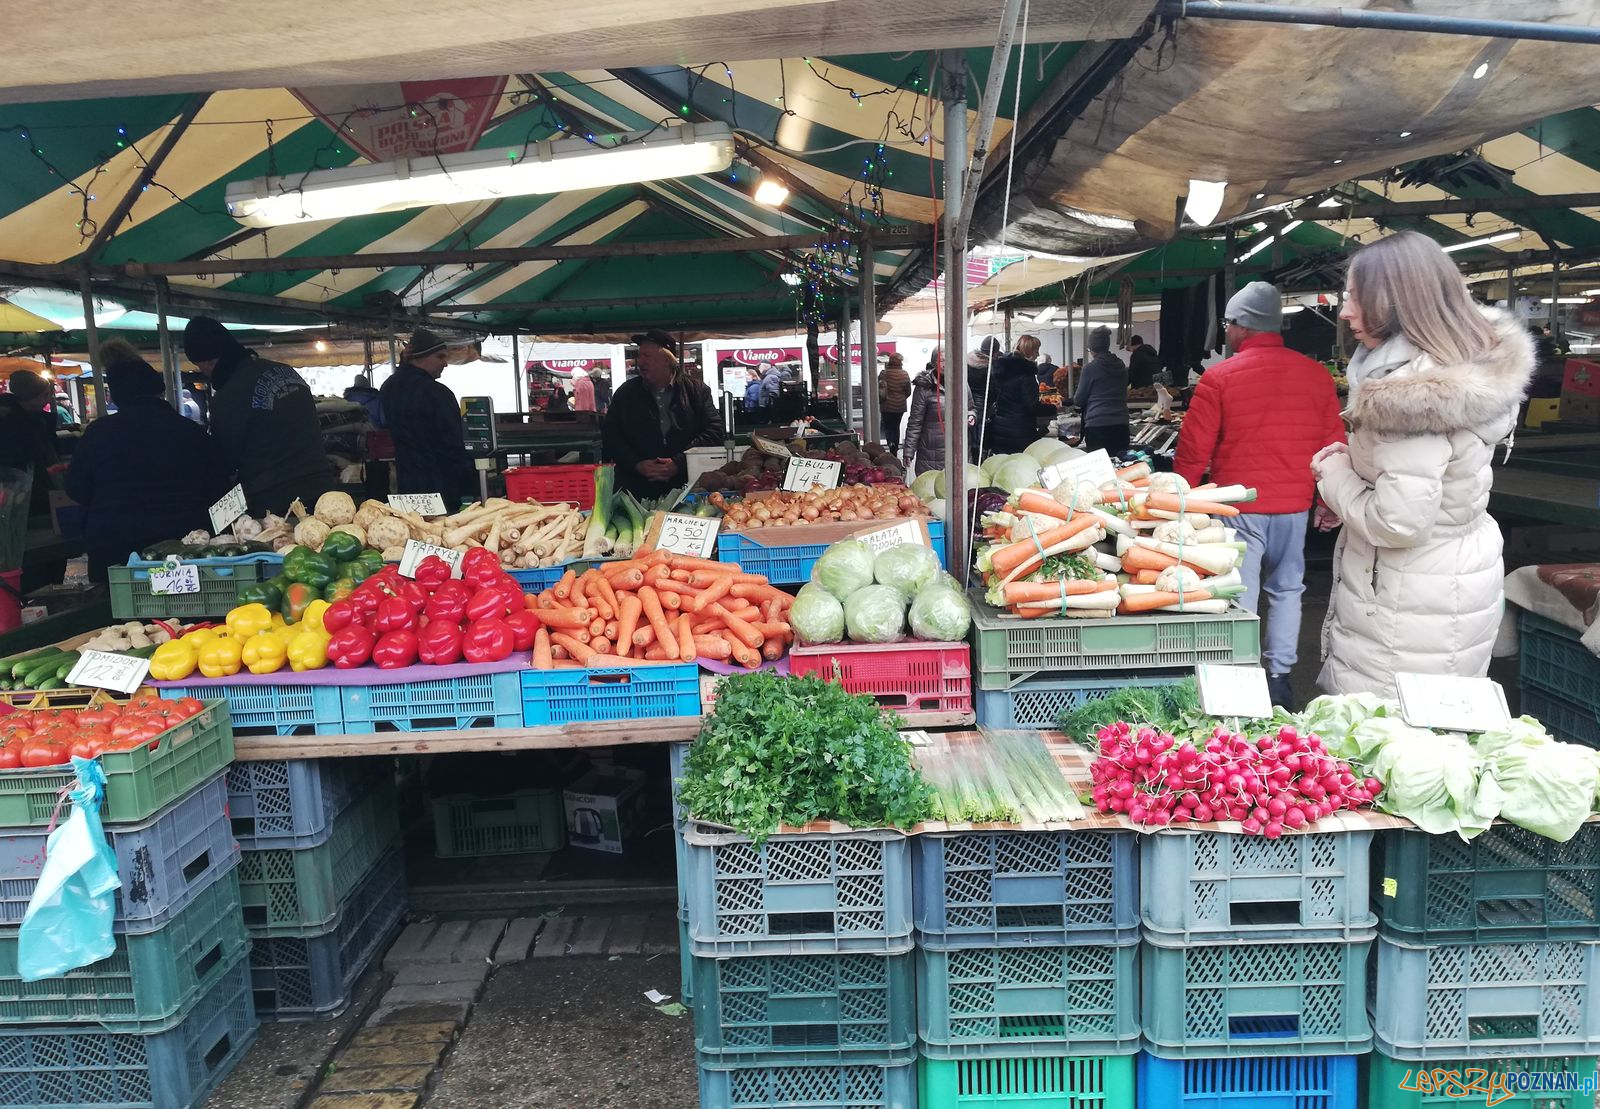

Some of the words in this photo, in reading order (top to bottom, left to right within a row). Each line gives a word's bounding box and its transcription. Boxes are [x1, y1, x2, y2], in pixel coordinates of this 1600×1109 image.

[892, 225, 908, 234] 205
[742, 349, 779, 361] Viando
[791, 459, 834, 470] CEBULA
[667, 517, 708, 527] MARCHEW
[662, 526, 680, 548] 3
[683, 527, 703, 538] 50
[863, 528, 899, 544] SAŁATA
[872, 536, 903, 552] ODOWA
[413, 541, 460, 560] PAPRYKA
[166, 579, 184, 593] 16
[87, 651, 138, 667] POMIDOR
[83, 664, 113, 681] 12
